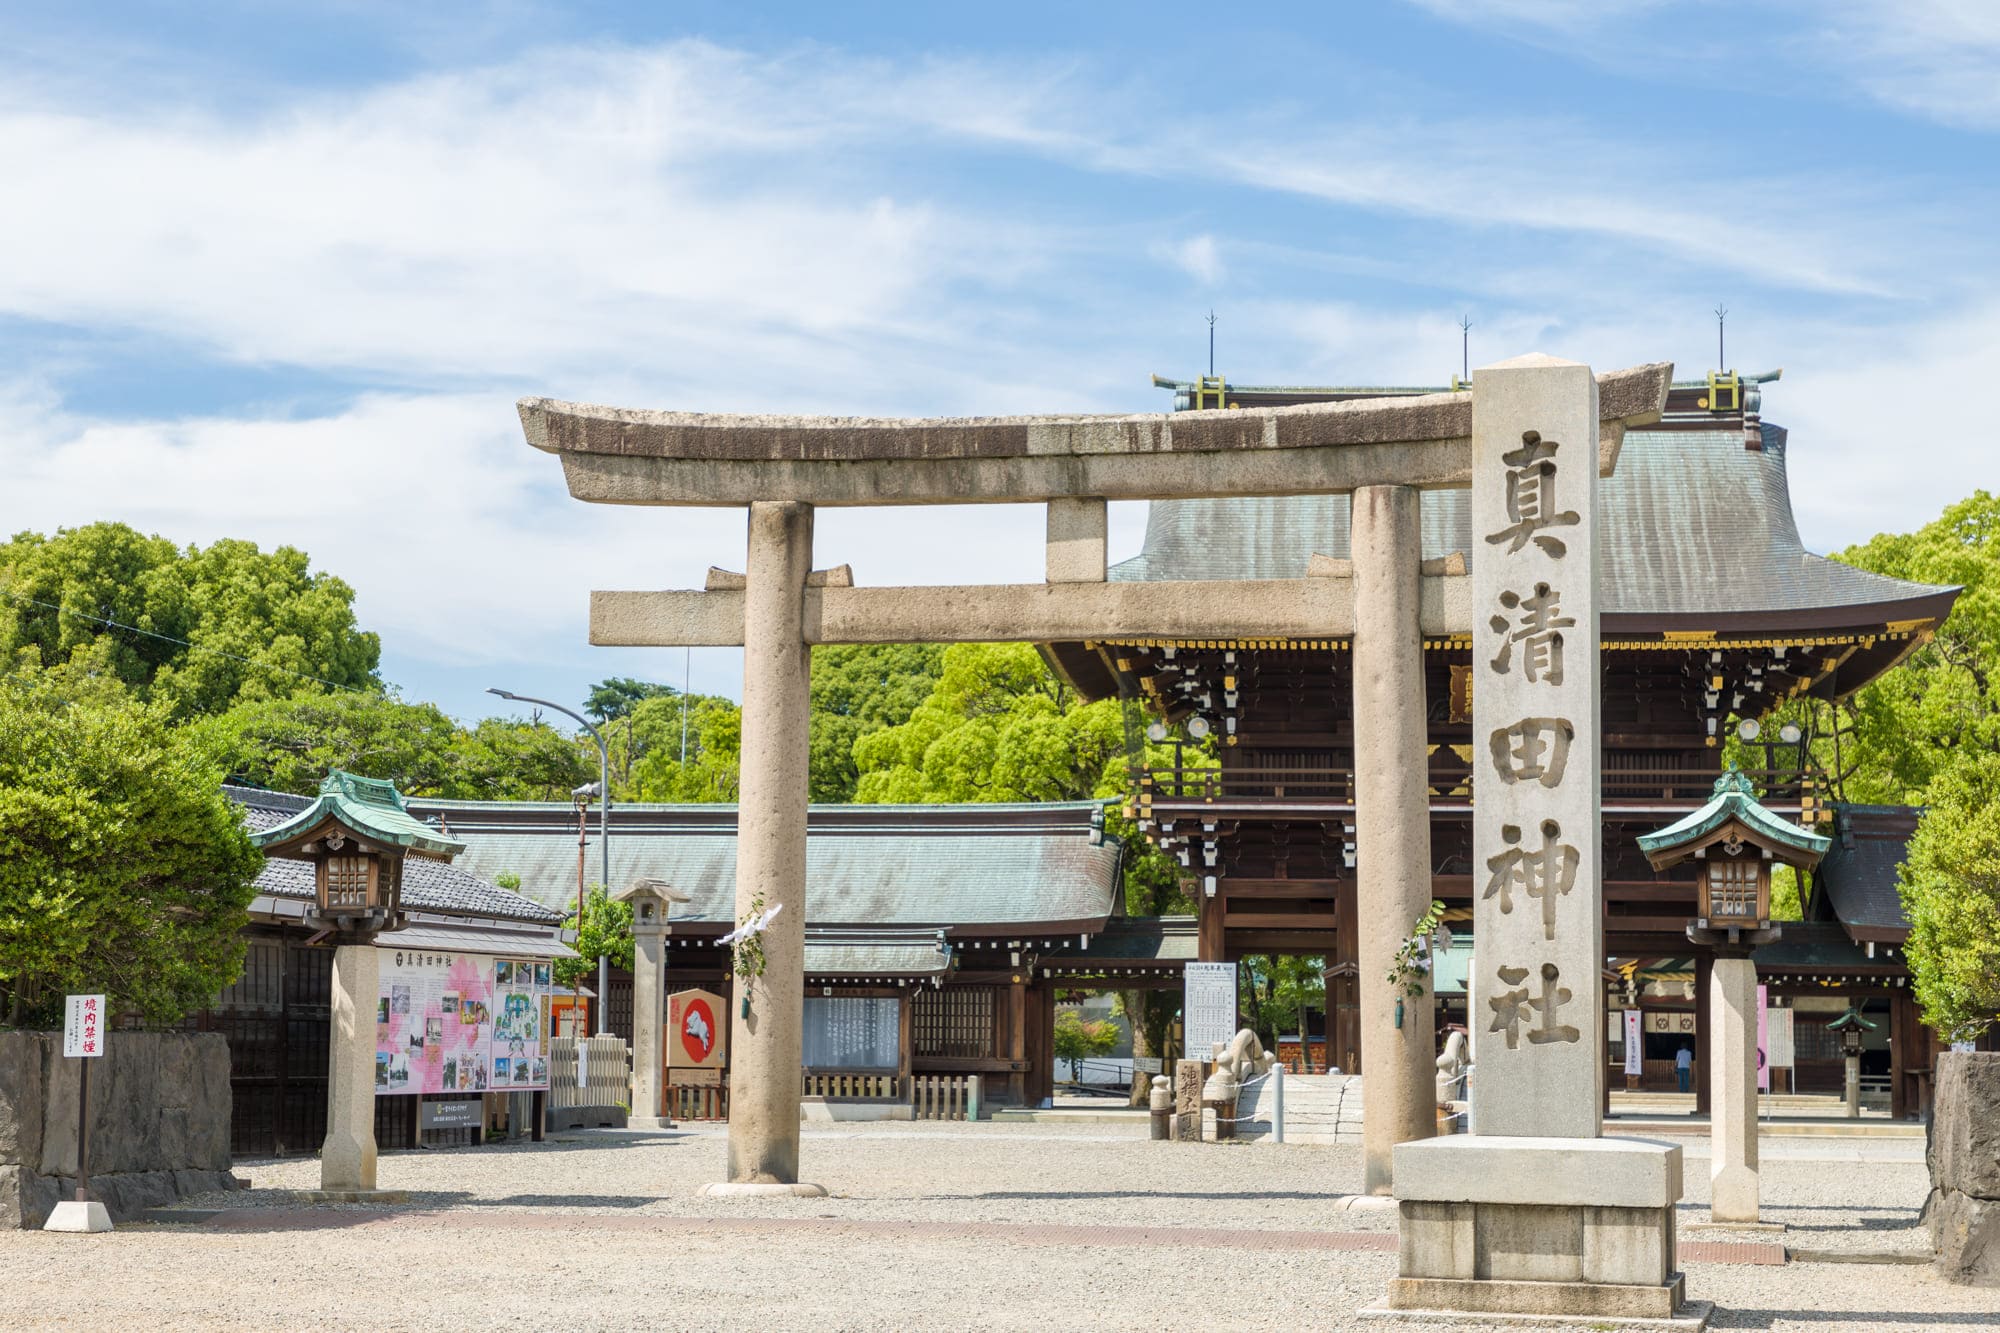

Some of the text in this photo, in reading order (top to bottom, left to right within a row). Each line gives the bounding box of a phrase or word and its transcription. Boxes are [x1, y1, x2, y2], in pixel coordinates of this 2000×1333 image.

[1483, 430, 1582, 1049] 真清田神社
[407, 952, 452, 968] 真清田神社
[83, 998, 97, 1053] 境内禁煙
